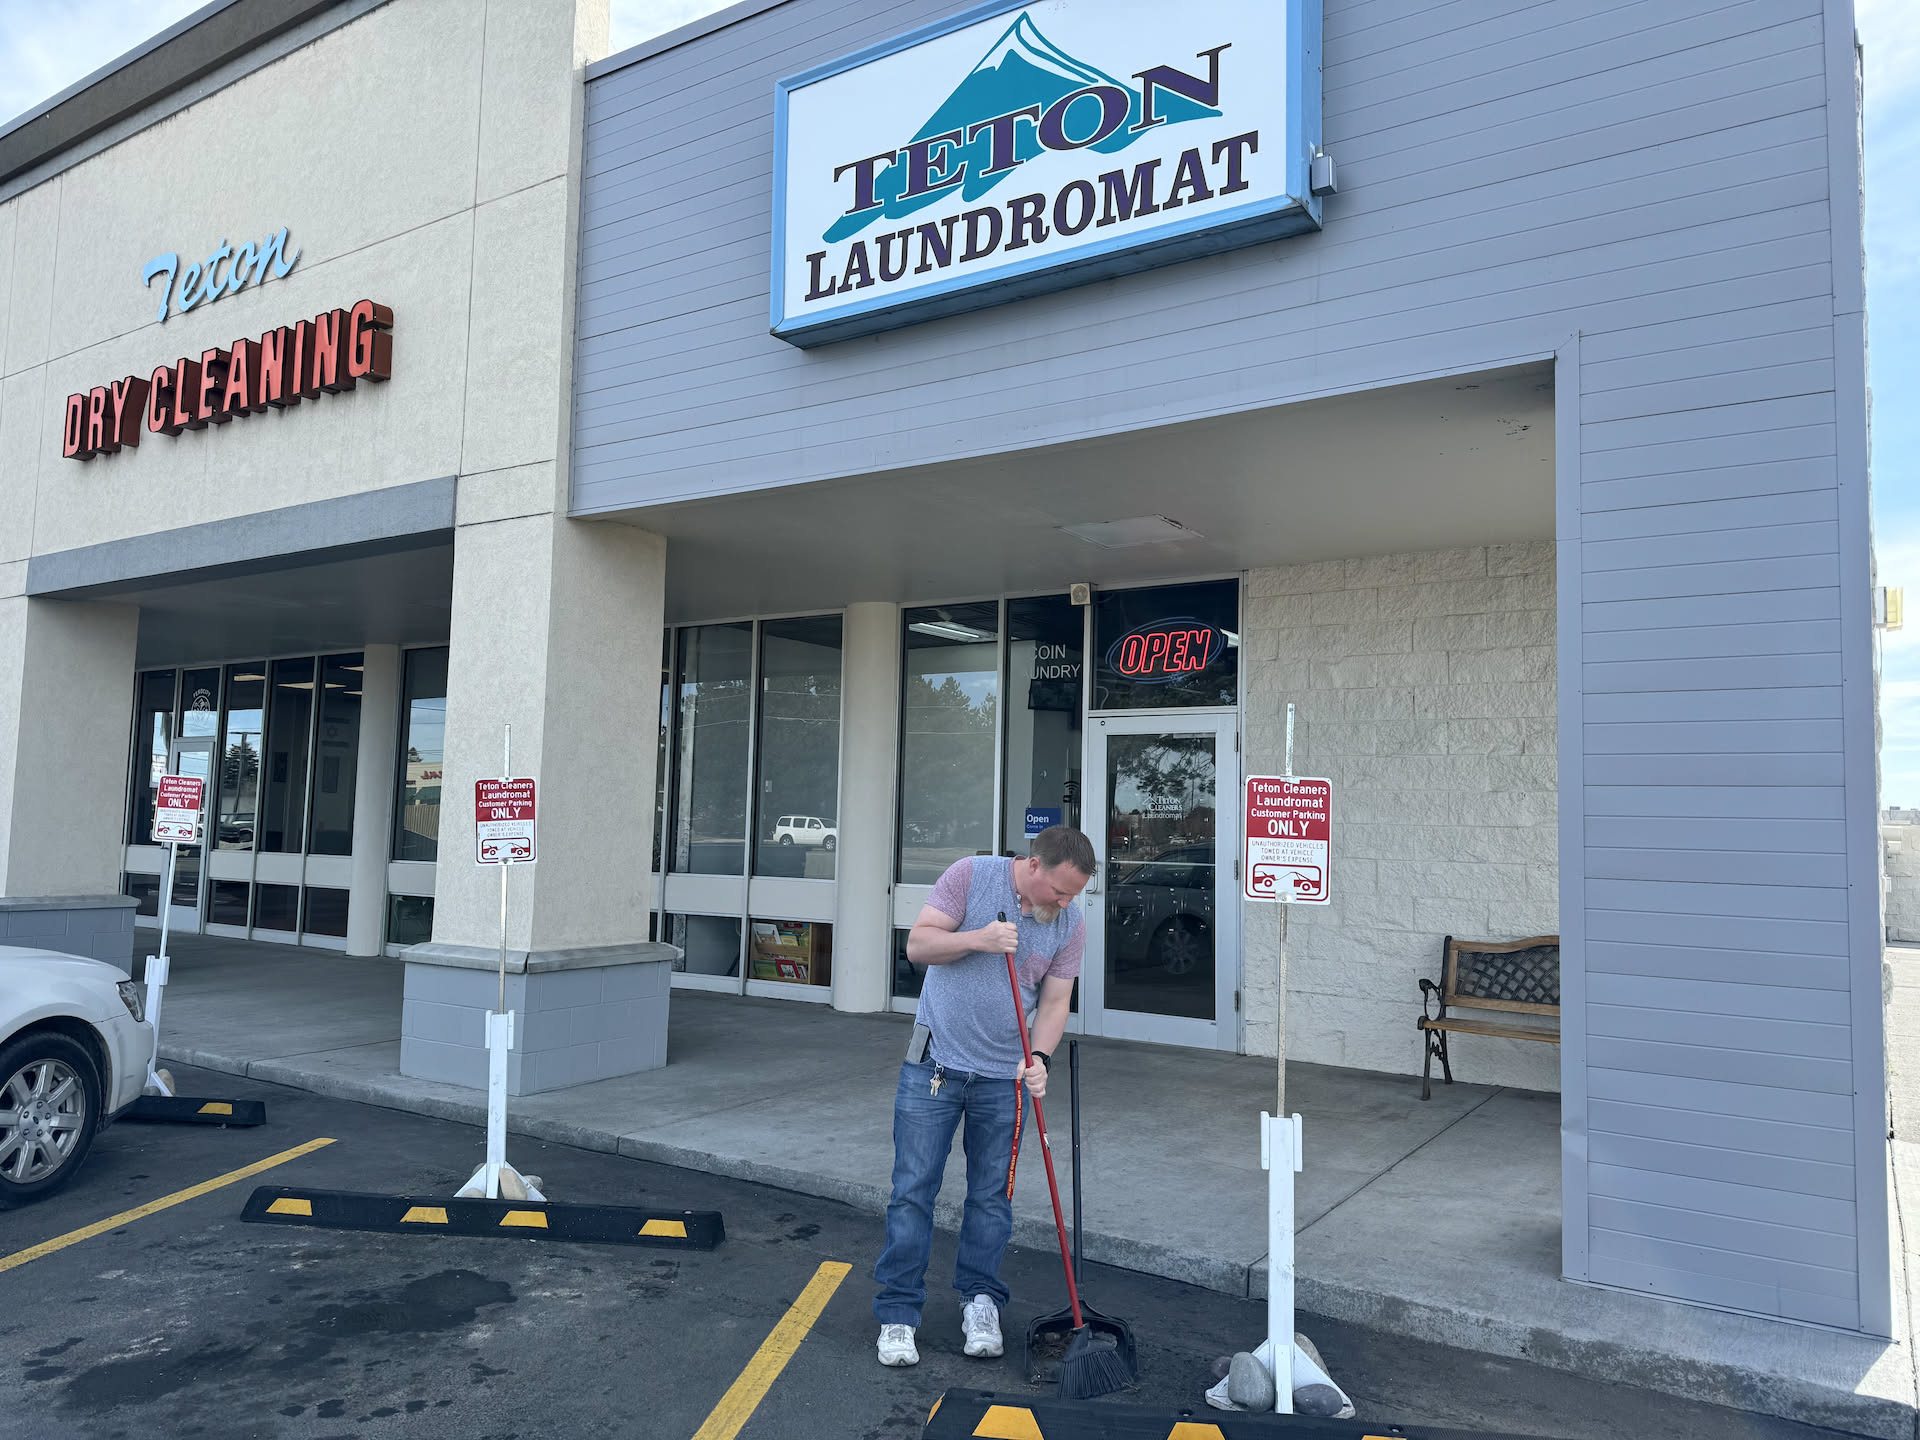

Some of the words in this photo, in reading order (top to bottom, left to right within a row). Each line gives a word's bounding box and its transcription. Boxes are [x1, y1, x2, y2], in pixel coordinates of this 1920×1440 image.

[833, 42, 1232, 216] TETON
[804, 130, 1259, 302] LAUNDROMAT
[142, 226, 300, 323] Teton
[62, 376, 146, 461] DRY
[147, 299, 391, 436] CLEANING
[1119, 629, 1211, 674] OPEN
[482, 790, 530, 799] Laundromat
[1252, 782, 1280, 793] Teton
[1283, 783, 1328, 795] Cleaners
[168, 798, 190, 808] ONLY
[1256, 795, 1323, 808] Laundromat
[491, 807, 521, 819] ONLY
[1026, 814, 1049, 824] Open
[1251, 808, 1290, 818] Customer
[1293, 810, 1326, 822] Parking
[1267, 819, 1309, 836] ONLY
